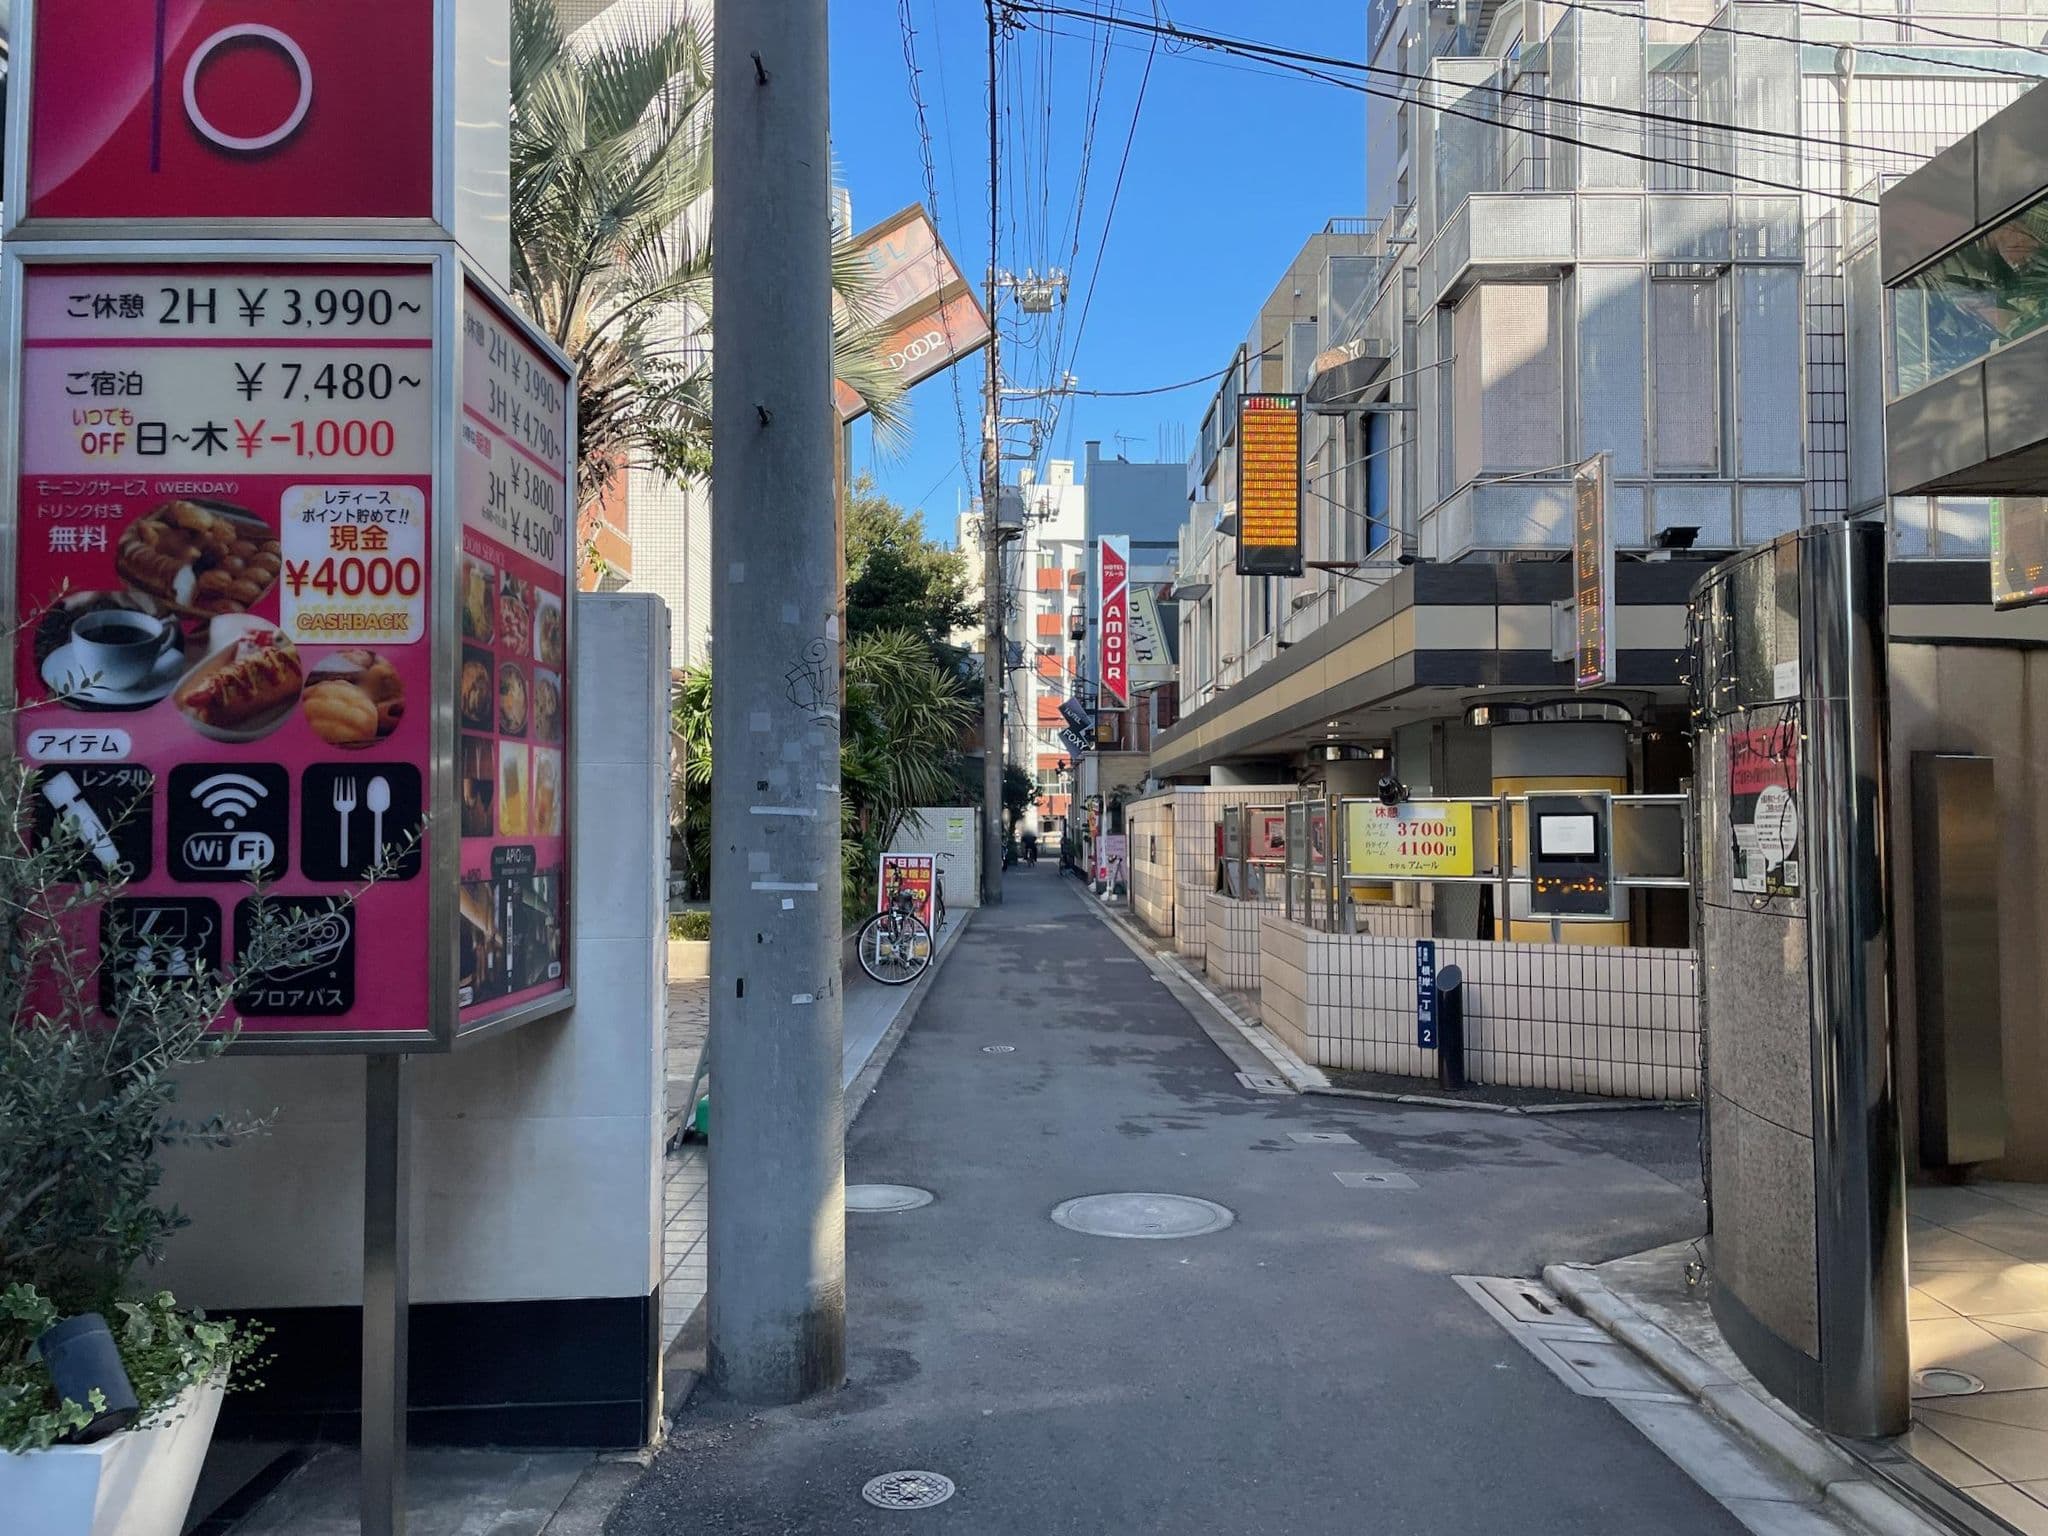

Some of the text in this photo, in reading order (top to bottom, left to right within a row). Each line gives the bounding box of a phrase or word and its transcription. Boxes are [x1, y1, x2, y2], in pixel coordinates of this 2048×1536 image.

[67, 292, 145, 319] ご休憩
[159, 287, 217, 324] 2H
[888, 331, 945, 371] DOOR
[65, 370, 143, 396] ご宿泊
[73, 408, 134, 426] いつでも
[81, 432, 126, 454] OFF
[37, 480, 149, 496] モーニングサービス
[324, 490, 391, 504] レディース
[37, 503, 124, 519] ドリンク付き
[48, 524, 108, 553] 無料
[329, 524, 389, 552] 現金
[285, 557, 421, 597] ¥4000
[296, 612, 409, 631] CASHBACK
[1105, 605, 1123, 680] AMOUR
[36, 735, 120, 754] アイテム
[1062, 729, 1089, 750] FOXY
[83, 769, 148, 787] レンタル
[248, 987, 345, 1007] ブロアバス
[1423, 1029, 1431, 1042] 2
